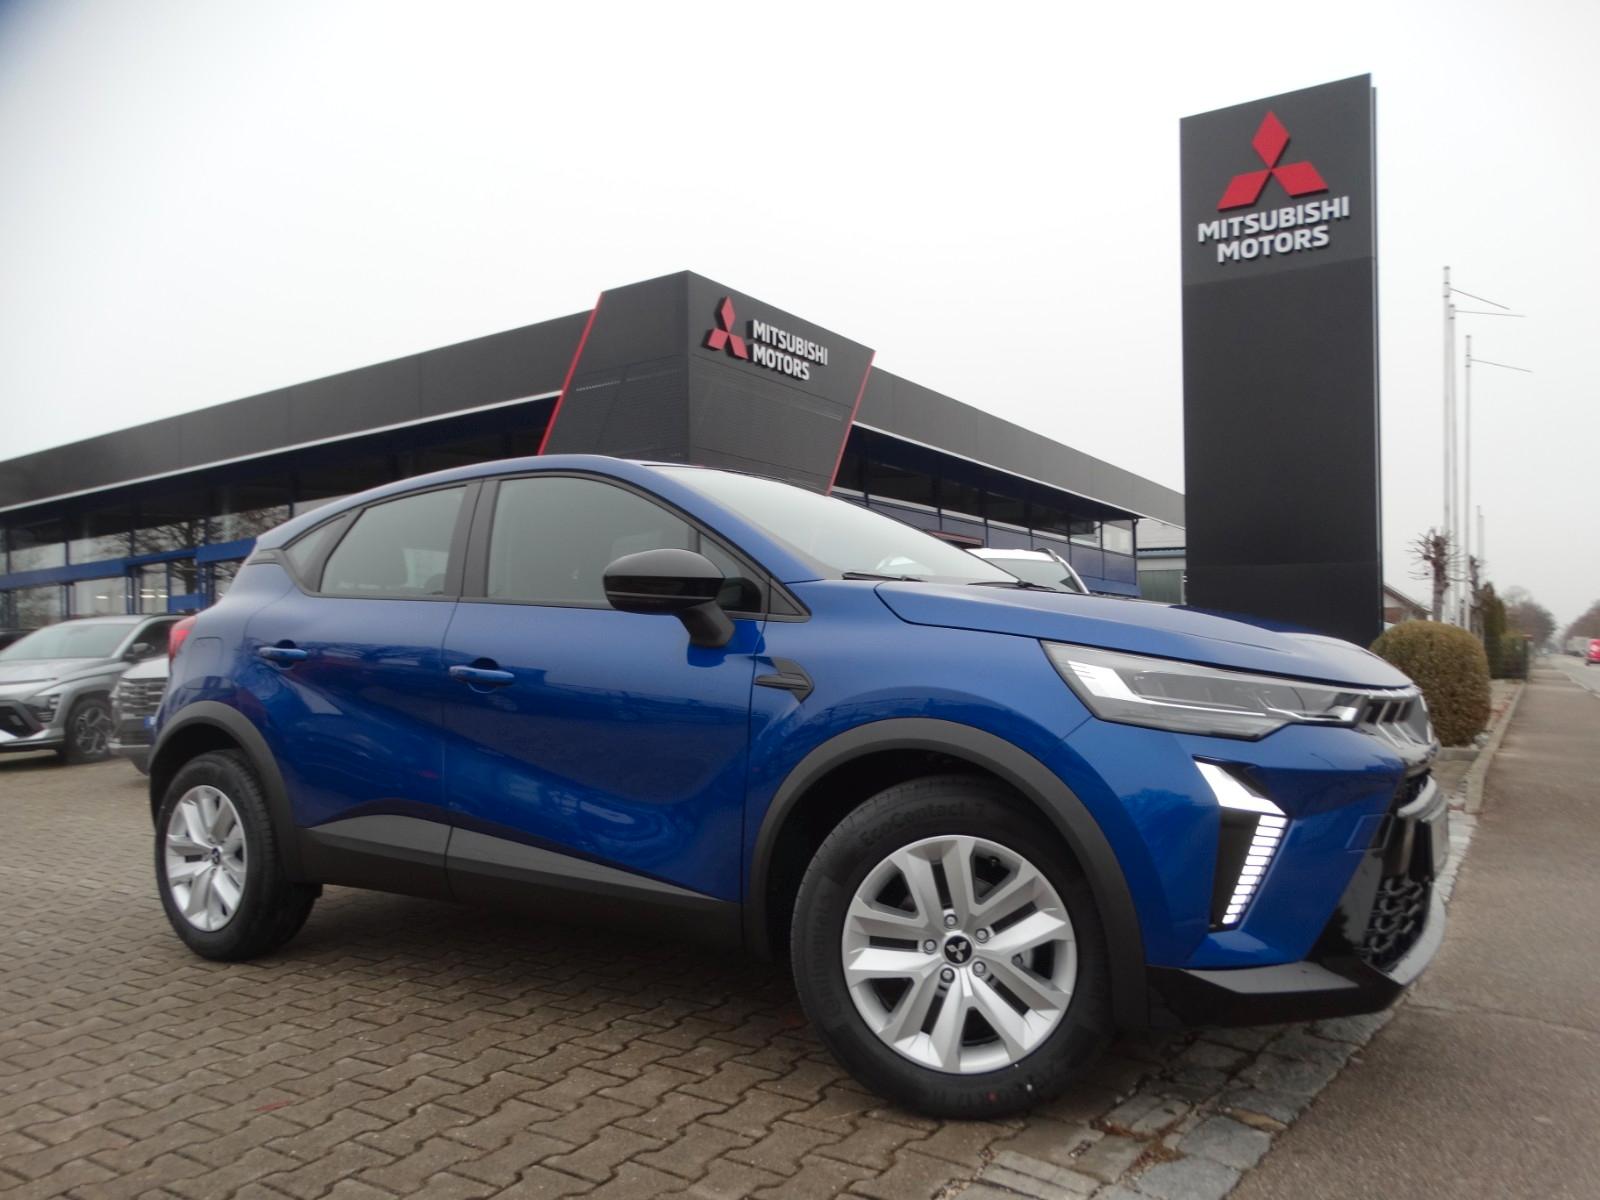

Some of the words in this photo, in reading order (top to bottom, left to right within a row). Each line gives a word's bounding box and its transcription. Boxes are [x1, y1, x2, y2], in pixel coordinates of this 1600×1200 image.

[1197, 196, 1350, 242] MITSUBISHI
[1217, 225, 1330, 263] MOTORS
[752, 319, 829, 366] MITSUBISHI
[752, 343, 811, 381] MOTORS
